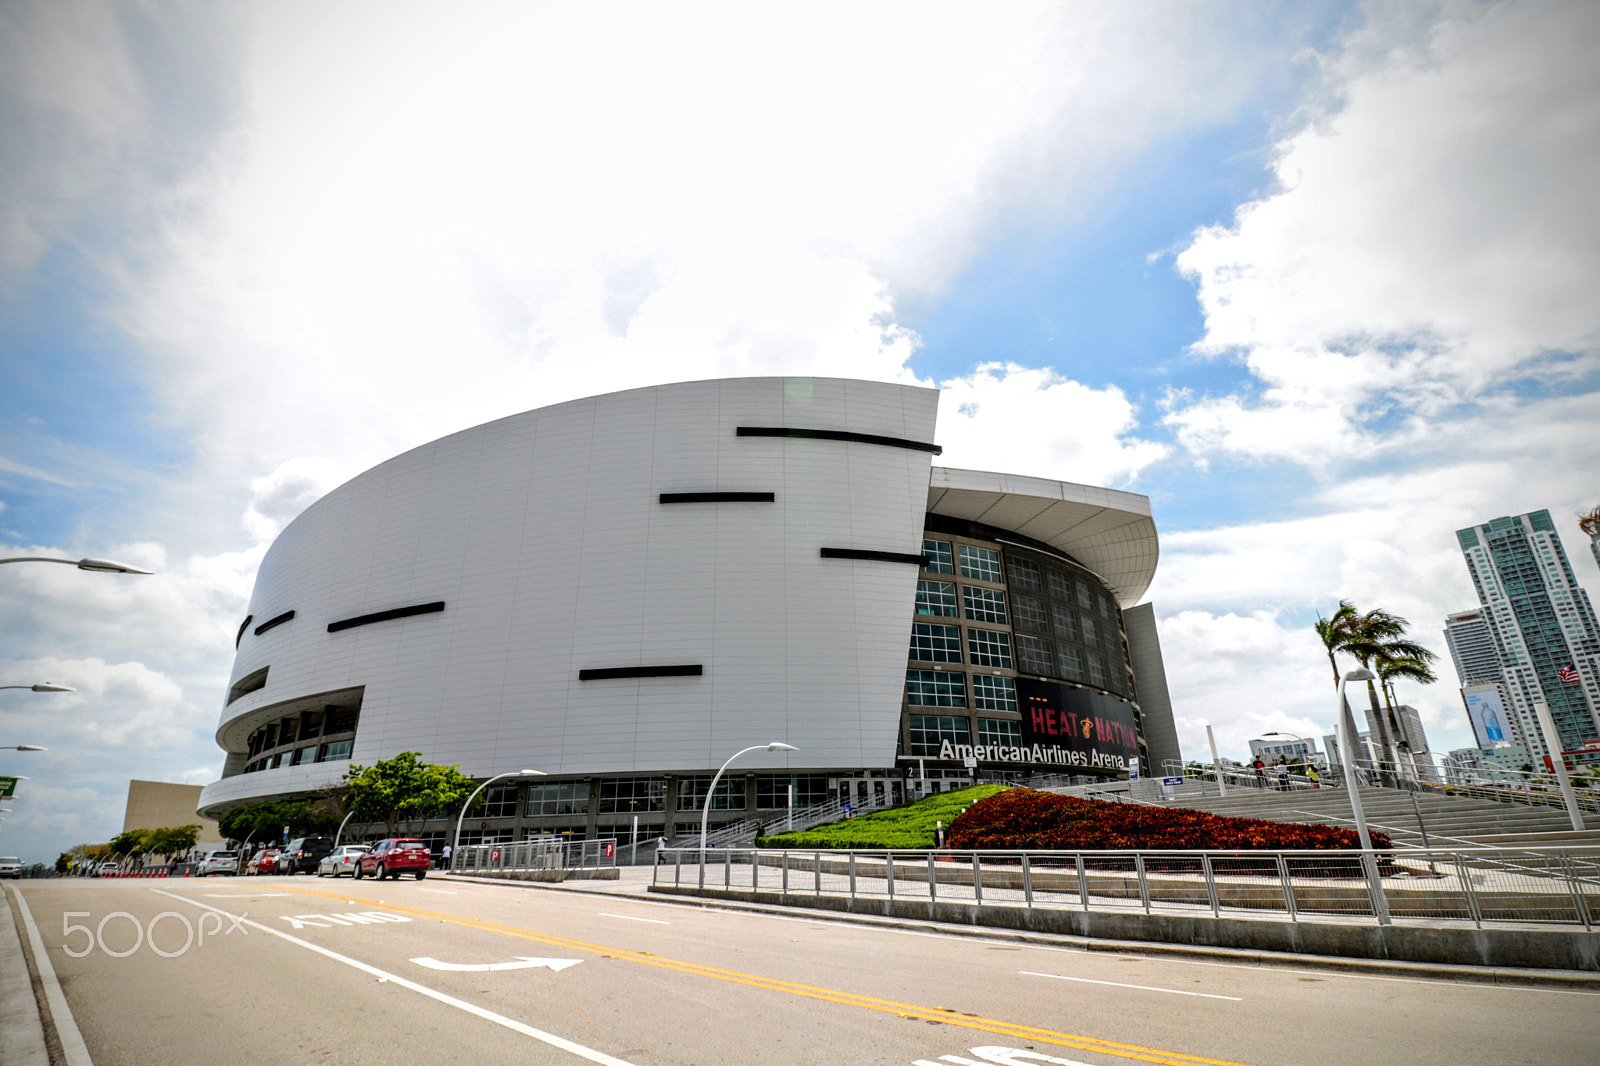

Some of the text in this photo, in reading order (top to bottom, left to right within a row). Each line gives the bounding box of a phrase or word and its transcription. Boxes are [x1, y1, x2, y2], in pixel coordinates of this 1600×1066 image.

[1031, 706, 1137, 749] HEAT NATION
[1090, 748, 1125, 769] Arena
[907, 766, 914, 778] 2
